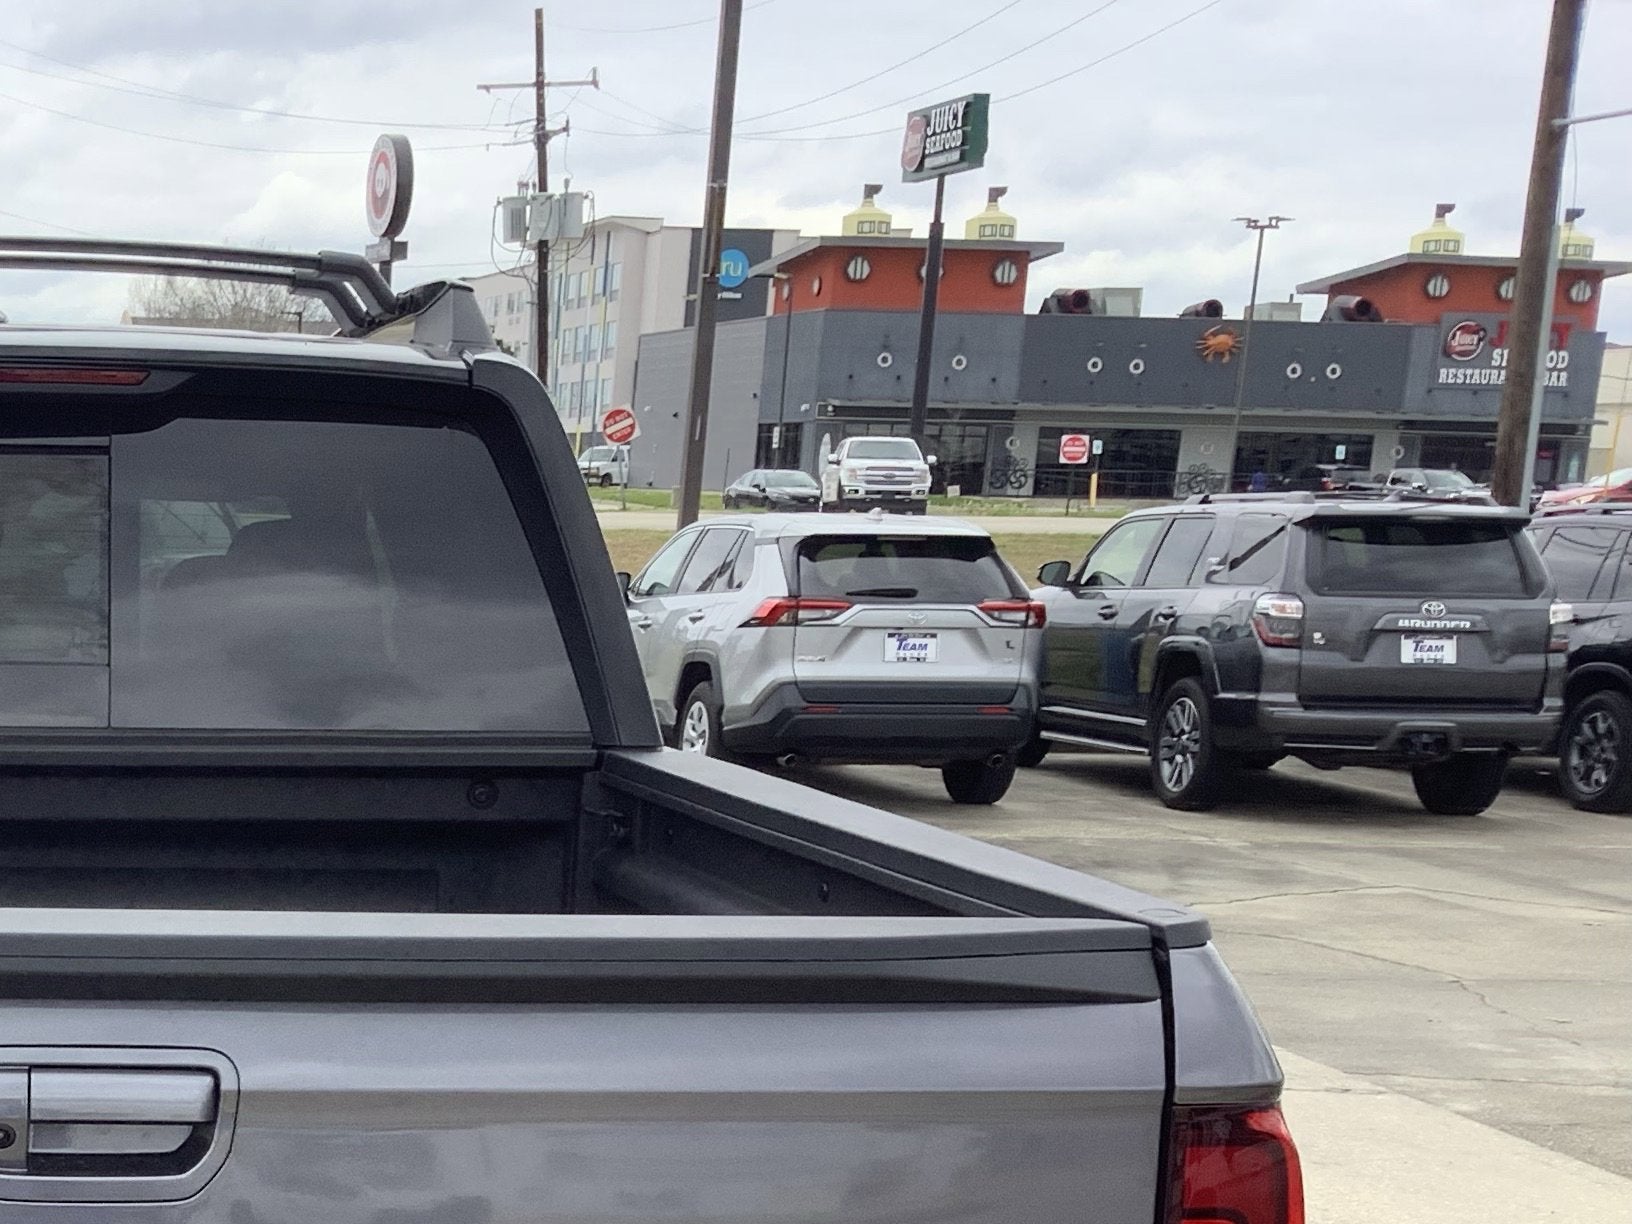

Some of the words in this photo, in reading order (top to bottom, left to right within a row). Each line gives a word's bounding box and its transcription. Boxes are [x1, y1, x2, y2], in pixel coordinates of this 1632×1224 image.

[927, 101, 966, 135] JUICY
[925, 129, 963, 154] SEAFOOD
[720, 261, 743, 277] ru
[1438, 367, 1507, 385] RESTAURA
[896, 637, 929, 651] TEAM
[1413, 639, 1445, 653] TEAM
